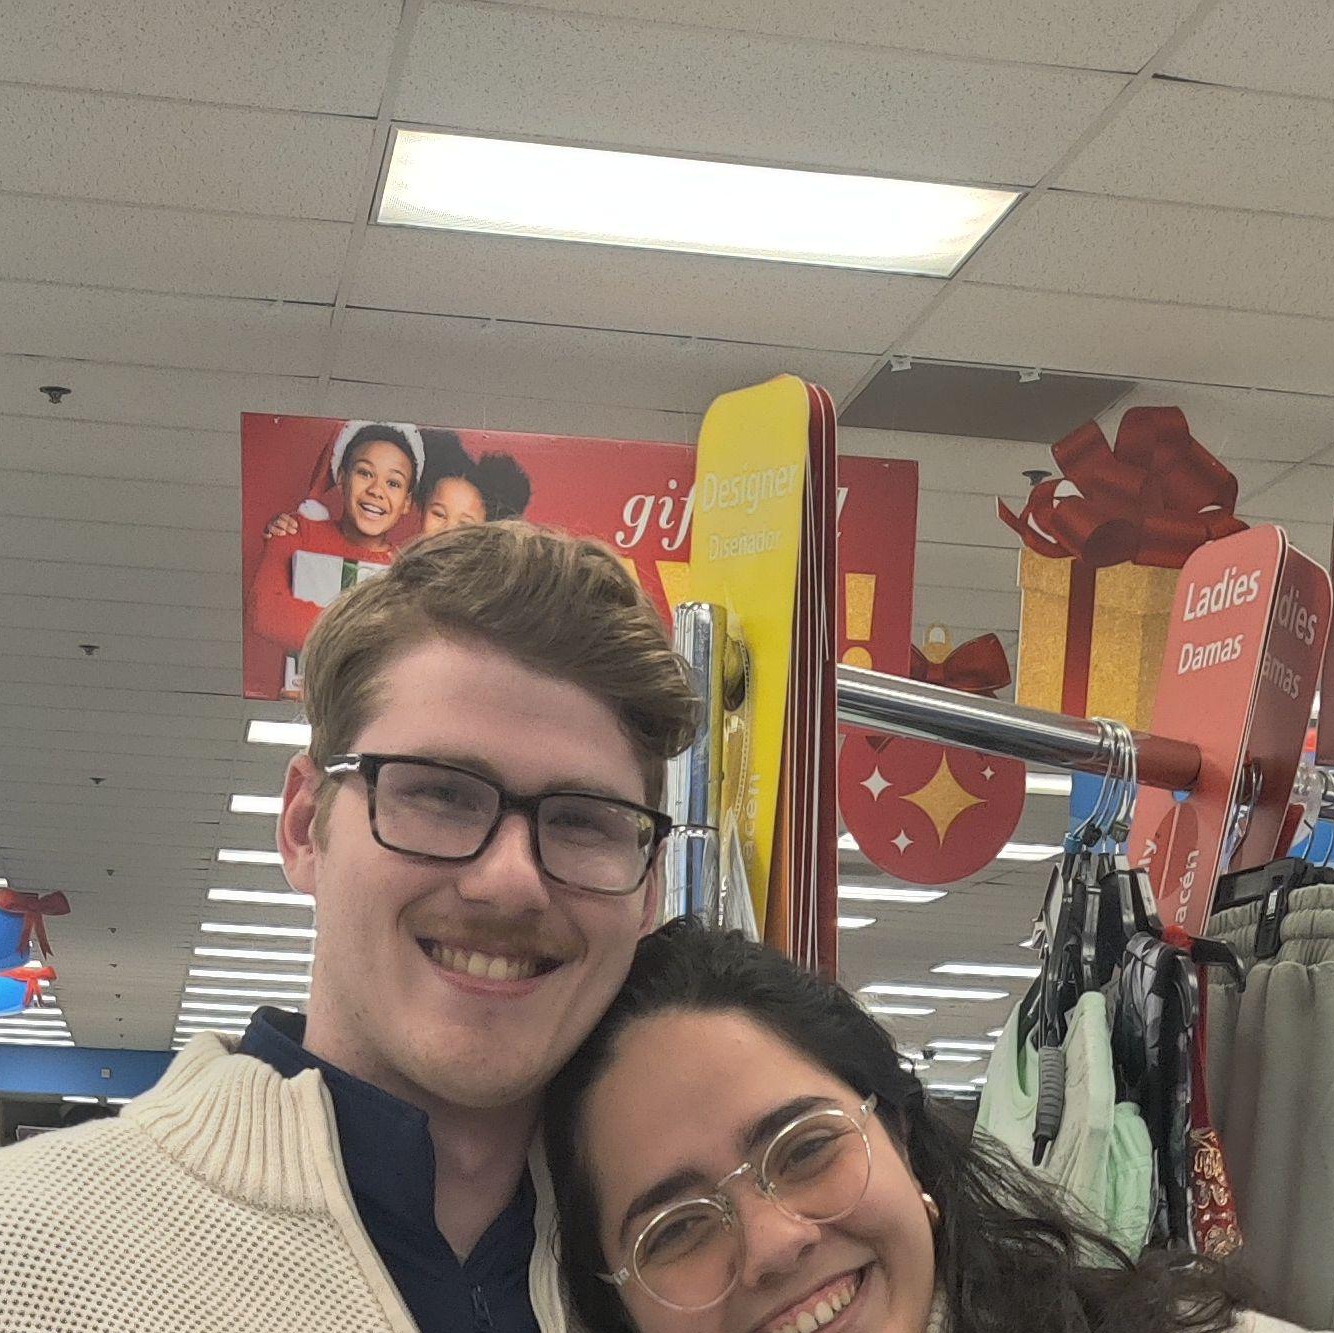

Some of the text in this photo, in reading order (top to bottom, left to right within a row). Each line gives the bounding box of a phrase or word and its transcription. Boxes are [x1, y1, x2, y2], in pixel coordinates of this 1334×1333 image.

[615, 479, 695, 551] gif
[702, 463, 799, 514] Designer
[1183, 566, 1262, 622] Ladies
[1275, 584, 1318, 646] dies
[1178, 634, 1245, 675] Damas
[1262, 651, 1302, 700] amas
[1175, 850, 1200, 923] acén
